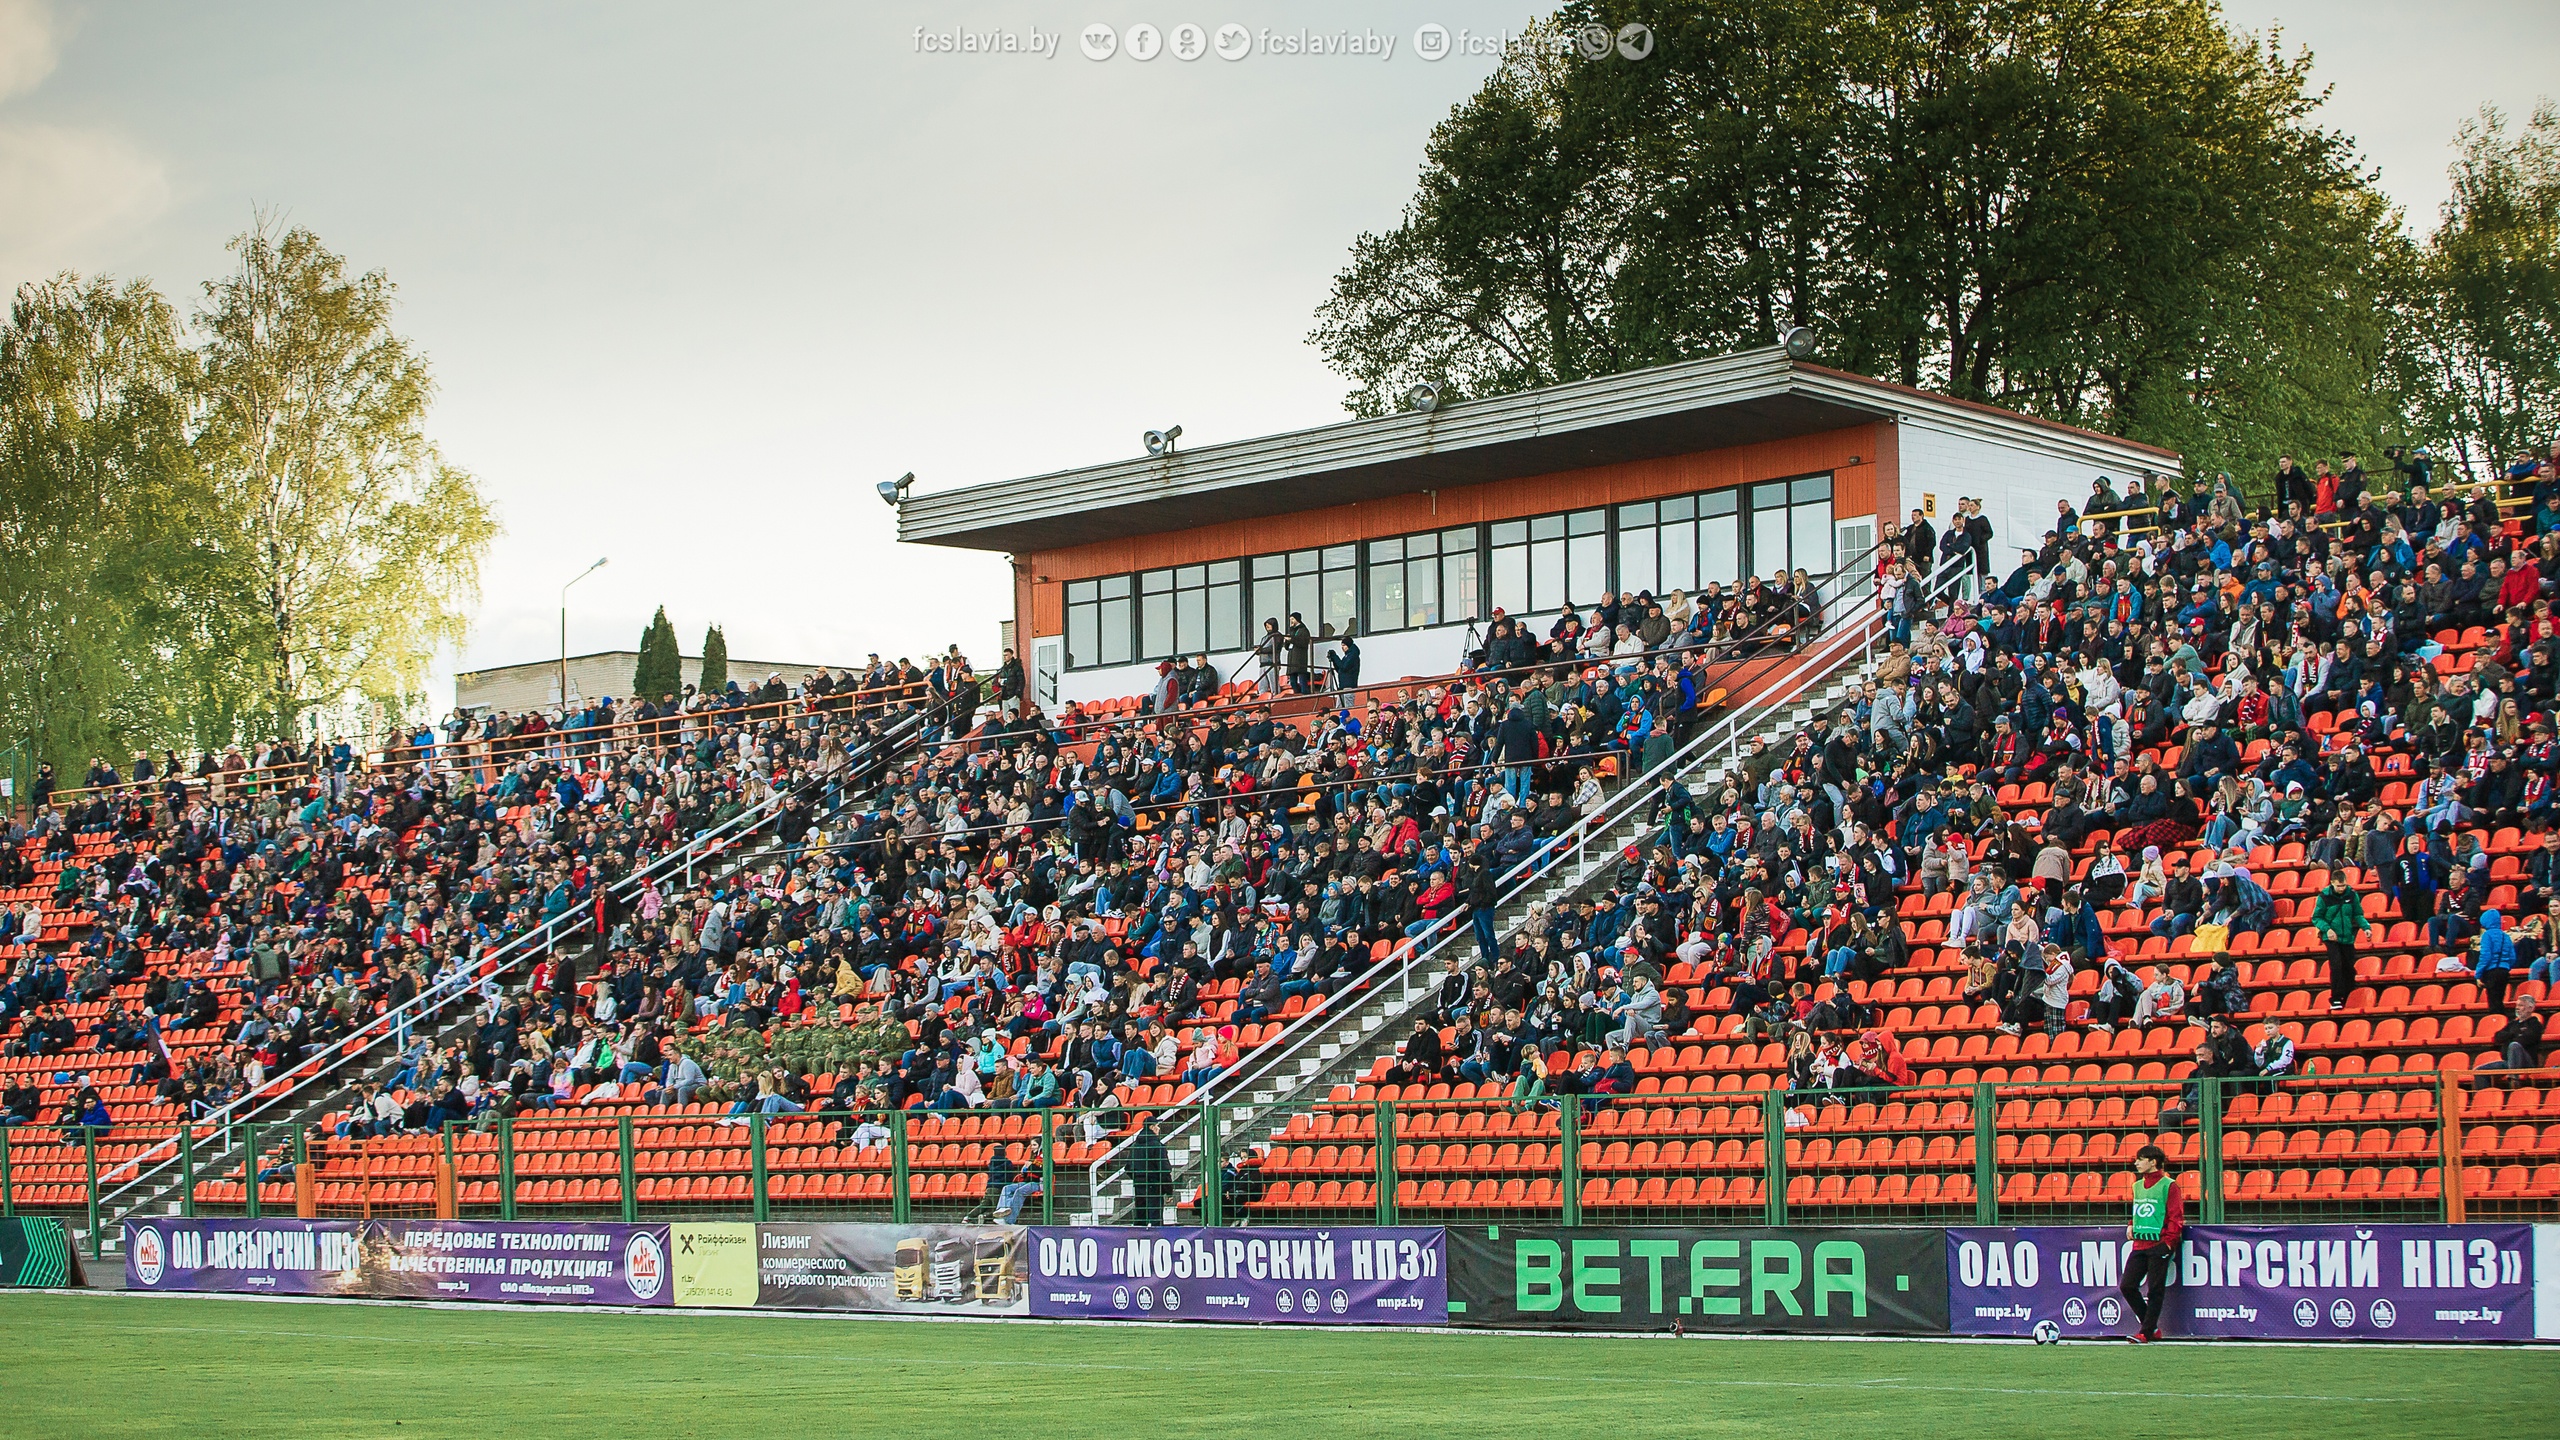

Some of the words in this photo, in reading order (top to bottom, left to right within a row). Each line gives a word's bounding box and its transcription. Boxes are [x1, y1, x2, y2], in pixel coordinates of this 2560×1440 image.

[404, 1231, 497, 1250] ПЕРЕДОВЫЕ
[501, 1233, 611, 1252] ТЕХНОЛОГИИ!
[697, 1233, 747, 1247] Райффайзен
[762, 1232, 812, 1249] Лизинг
[172, 1230, 202, 1270] ОАО
[1038, 1237, 1098, 1278] ОАО
[1112, 1232, 1337, 1281] «МОЗЫРСКИЙ
[1351, 1238, 1438, 1282] НПЗ»
[389, 1255, 506, 1275] КАЧЕСТВЕННАЯ
[510, 1259, 613, 1280] ПРОДУКЦИЯ!
[762, 1257, 847, 1272] коммерческого
[1958, 1240, 2039, 1288] ОАО
[2060, 1229, 2380, 1289] «МЫРСКИЙ
[2402, 1239, 2522, 1289] НПЗ»
[763, 1274, 771, 1285] и
[773, 1274, 825, 1289] грузового
[826, 1275, 887, 1290] транспорта
[1515, 1239, 1867, 1318] BETERA
[1050, 1290, 1092, 1306] mnpz.by
[1205, 1293, 1250, 1309] mnpz.by
[1376, 1294, 1425, 1311] mnpz.by
[1974, 1305, 2032, 1321] mnpz.by
[2194, 1305, 2258, 1322] mnpz.by
[2434, 1306, 2503, 1325] mnpz.by
